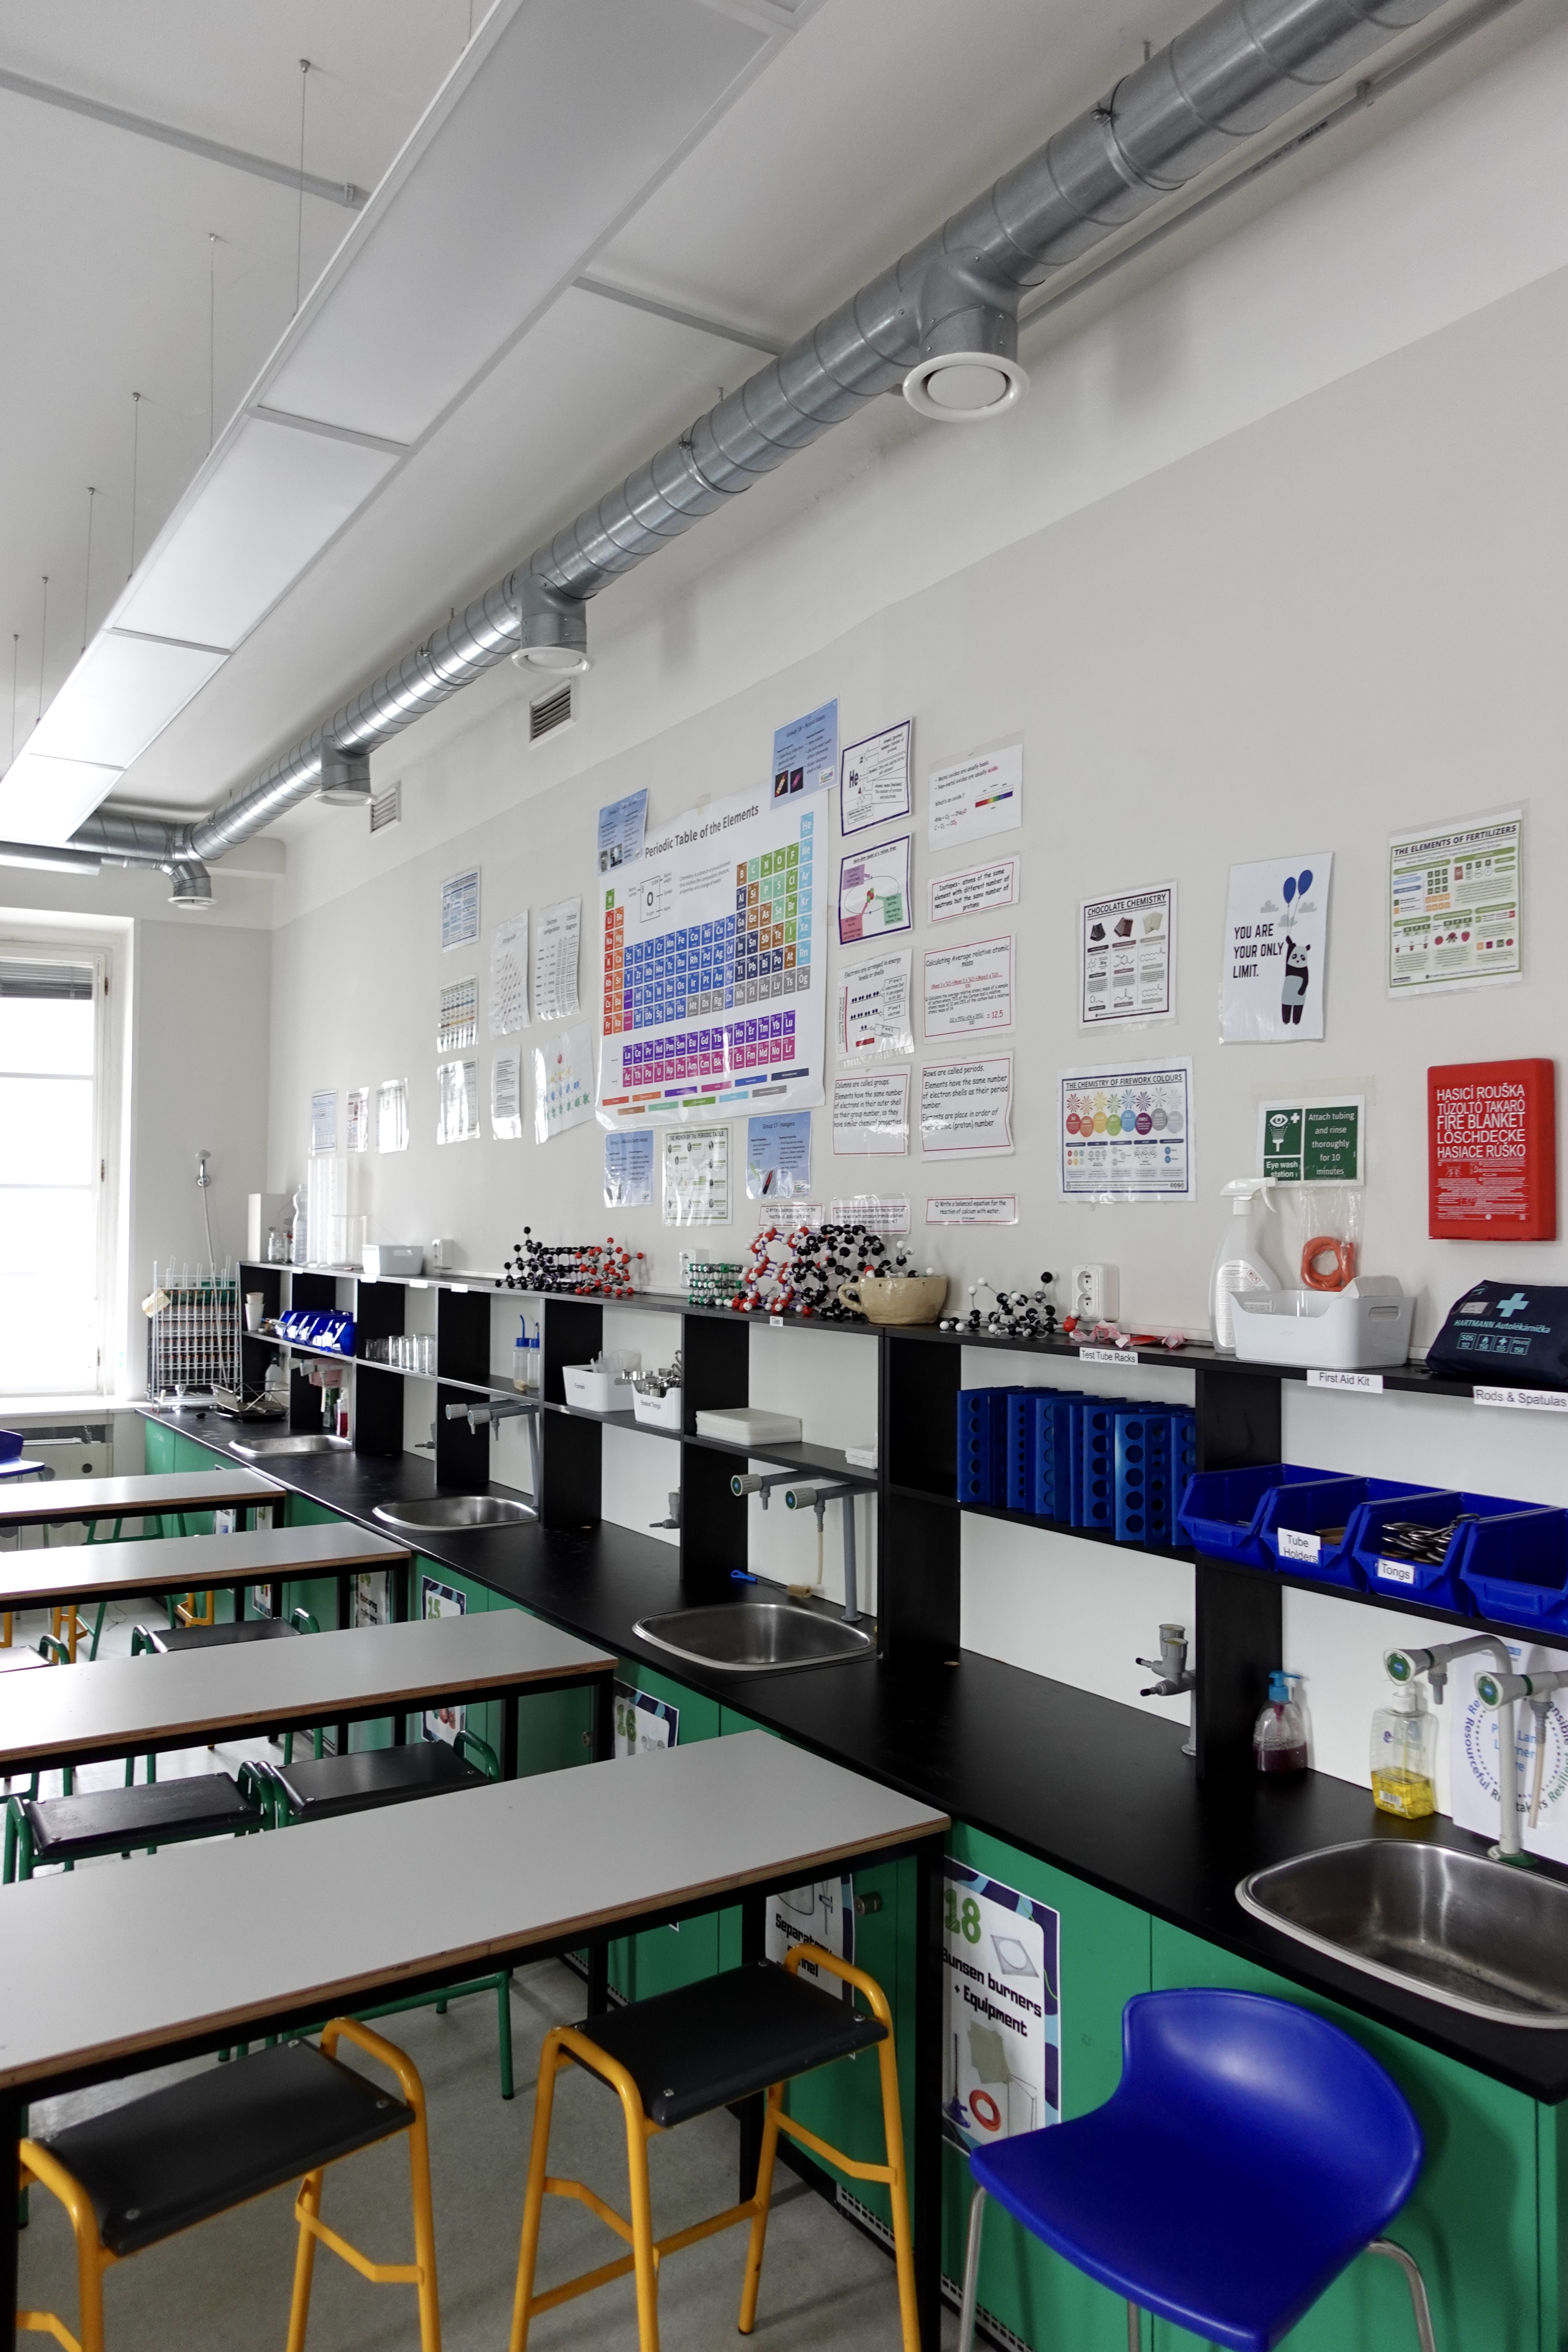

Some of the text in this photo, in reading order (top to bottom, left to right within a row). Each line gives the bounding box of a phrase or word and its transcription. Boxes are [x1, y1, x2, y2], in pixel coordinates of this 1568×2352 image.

[849, 769, 859, 788] He
[645, 805, 759, 858] Periodic Table of the Elements
[803, 821, 812, 831] He
[1395, 825, 1517, 855] THE ELEMENTS OF FERTILIZERS
[777, 856, 782, 865] O
[791, 851, 794, 859] F
[751, 865, 756, 874] C
[765, 861, 769, 869] N
[740, 870, 744, 878] B
[789, 876, 795, 885] Cl
[751, 888, 756, 898] Si
[935, 892, 951, 900] element
[964, 883, 984, 893] different
[986, 878, 1002, 887] number
[647, 891, 653, 907] O
[934, 900, 953, 909] neutrons
[985, 886, 1002, 896] number
[788, 901, 795, 911] Br
[963, 902, 980, 911] protons
[1088, 893, 1166, 916] CHOCOLATE CHEMISTRY
[691, 933, 698, 941] Co
[1234, 923, 1274, 939] YOU ARE
[679, 936, 685, 945] Fe
[749, 939, 756, 947] Sn
[787, 952, 793, 961] At
[925, 944, 1009, 967] Calculating Average relative atomic
[1234, 942, 1284, 959] YOUR ONLY
[749, 962, 756, 972] Pb
[1233, 964, 1259, 978] LIMIT.
[799, 974, 808, 985] Og
[992, 1010, 1003, 1019] 12.5
[786, 1019, 793, 1028] Lu
[772, 1047, 779, 1056] No
[947, 1066, 962, 1075] called
[964, 1064, 984, 1075] periods.
[925, 1081, 948, 1090] Elements
[987, 1075, 1008, 1083] number
[1078, 1079, 1109, 1089] CHEMISTRY
[1120, 1076, 1151, 1085] FIREWORK
[1153, 1074, 1182, 1082] COLOURS
[952, 1088, 967, 1097] shells
[990, 1084, 1009, 1095] period
[1437, 1082, 1525, 1101] HASICÍ ROUŠKA
[1484, 1096, 1526, 1113] TAKARÓ
[1308, 1112, 1355, 1121] Attach tubing
[1437, 1112, 1526, 1130] FIRE BLANKET
[1437, 1129, 1526, 1144] LÖSCHDECKE
[1312, 1140, 1350, 1149] thoroughly
[1437, 1141, 1526, 1158] HASIACE RÚŠKO
[1266, 1162, 1279, 1170] Eye
[1317, 1166, 1344, 1175] minutes
[1453, 1319, 1495, 1328] HARTMANN
[1081, 1350, 1135, 1363] Test Tube Racks
[1319, 1372, 1370, 1386] First Aid Kit
[1476, 1389, 1567, 1407] Rods & Spatulas
[1287, 1534, 1309, 1547] Tube
[1284, 1547, 1318, 1563] Holders
[1381, 1563, 1410, 1580] Tongs
[428, 1596, 441, 1619] 15
[617, 1704, 637, 1742] 16
[1464, 1717, 1491, 1790] Resourceful
[944, 1888, 981, 1944] 18
[988, 1972, 1042, 2018] burners
[954, 1984, 1028, 2037] + Equipment
